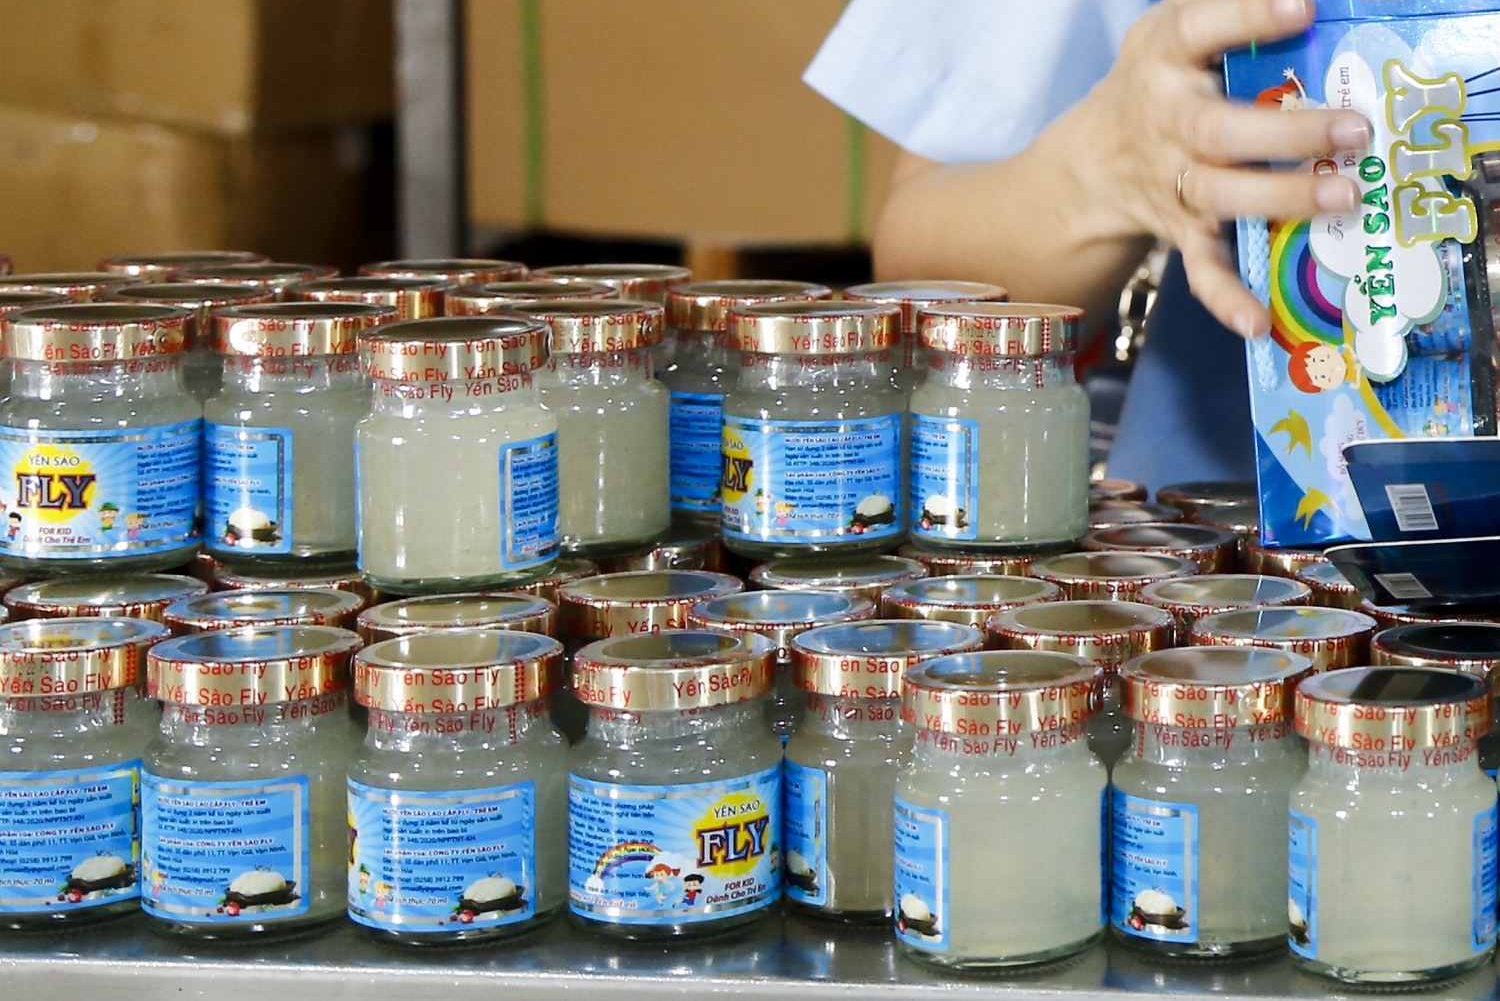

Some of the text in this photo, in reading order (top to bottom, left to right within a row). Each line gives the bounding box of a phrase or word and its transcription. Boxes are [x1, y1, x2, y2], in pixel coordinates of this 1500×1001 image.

[1341, 66, 1349, 87] em
[1383, 58, 1478, 248] FLY
[292, 318, 315, 334] Fly
[744, 336, 759, 353] Fly
[848, 332, 865, 349] Fly
[1008, 341, 1028, 355] Fly
[723, 457, 753, 493] LY
[17, 471, 95, 510] FLY
[41, 676, 78, 693] Sào
[86, 673, 111, 690] Fly
[366, 665, 380, 686] Fly
[475, 667, 499, 685] Fly
[199, 689, 232, 705] Sào
[241, 689, 267, 705] Fly
[610, 687, 631, 707] Fly
[673, 677, 707, 698] Yến
[709, 671, 739, 692] Sào
[1214, 685, 1237, 704] Fly
[471, 714, 495, 734] Fly
[1216, 730, 1233, 749] Fly
[1391, 735, 1416, 750] Fly
[1389, 752, 1411, 771] Fly
[697, 814, 769, 868] FLY
[725, 878, 754, 891] FOR KID
[707, 893, 729, 903] Dành
[731, 891, 745, 899] Cho
